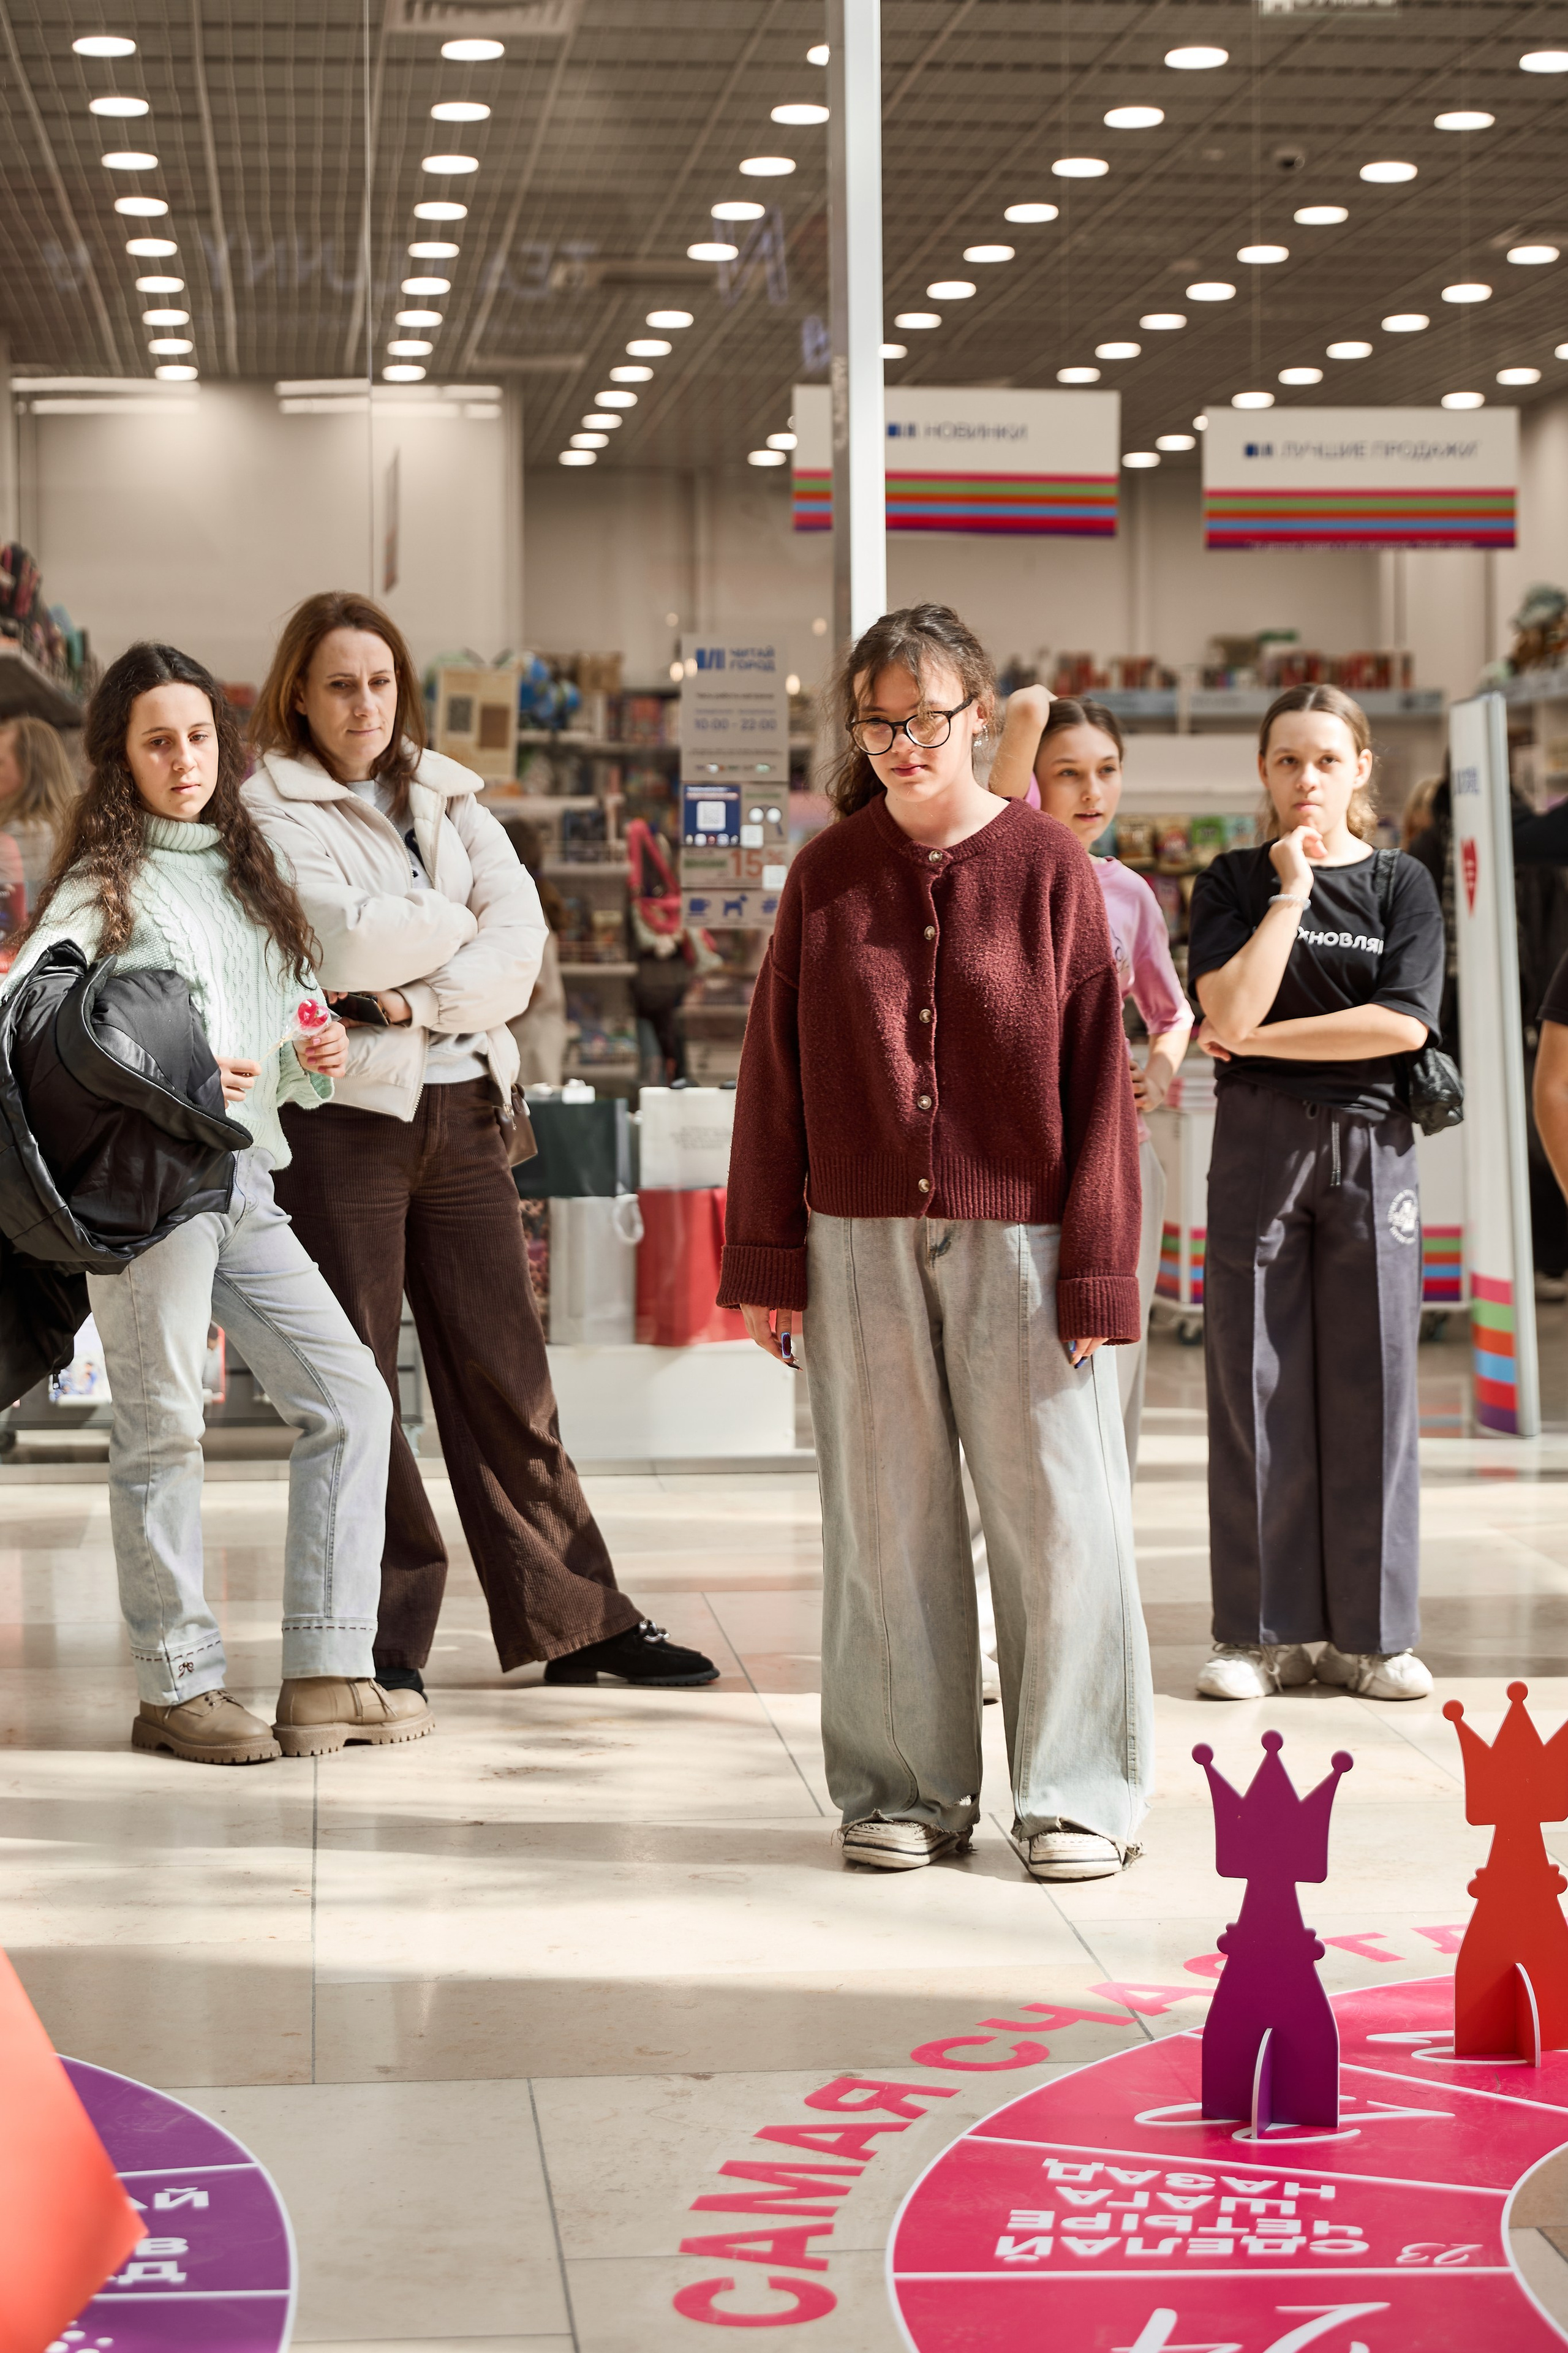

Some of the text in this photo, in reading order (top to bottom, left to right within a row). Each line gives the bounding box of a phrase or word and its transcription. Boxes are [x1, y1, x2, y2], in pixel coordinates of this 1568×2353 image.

[1297, 925, 1384, 956] ХНОВЛЯ
[1042, 2158, 1336, 2199] НАЗАД
[672, 2076, 963, 2327] САМАЯ
[1055, 2185, 1297, 2214] ШАГА
[1006, 2208, 1363, 2235] ЧЕТЫРЕ
[994, 2235, 1370, 2262] СДЕЛАЙ
[1395, 2242, 1484, 2265] 23
